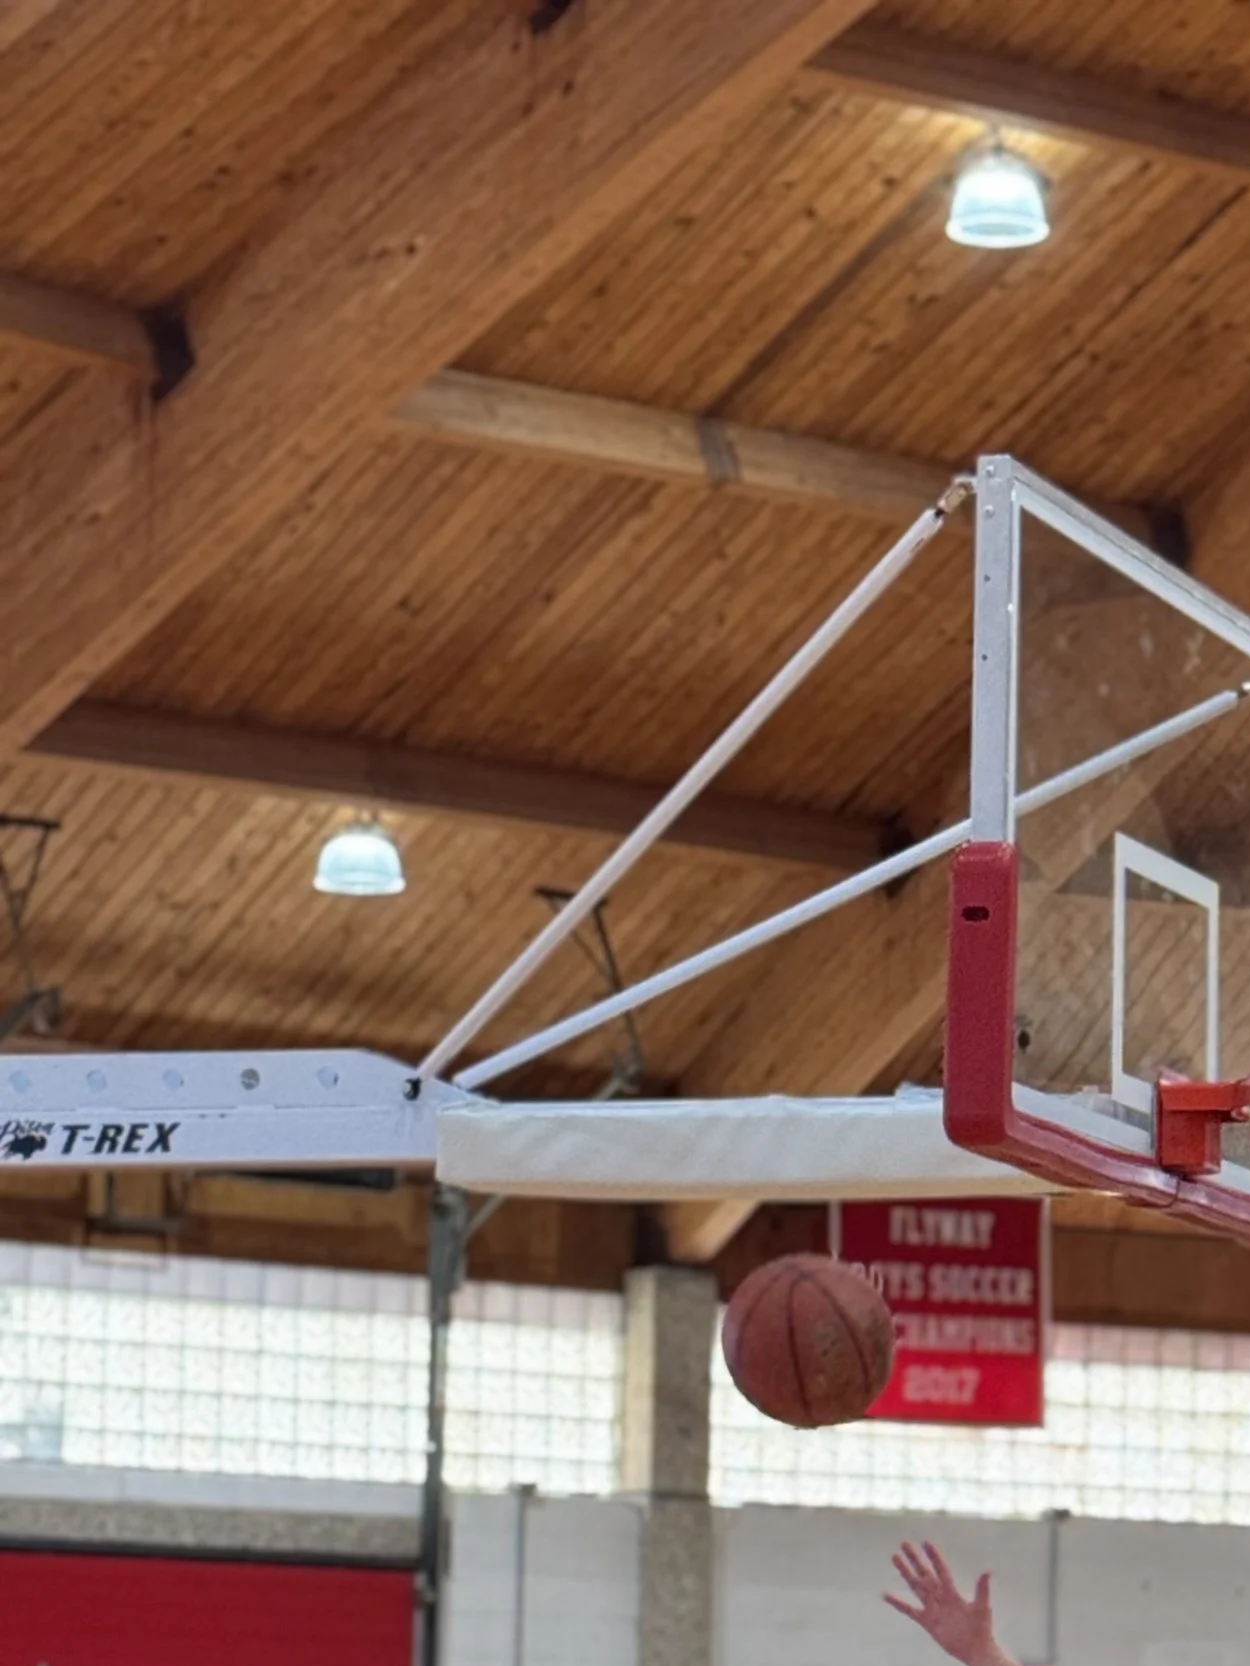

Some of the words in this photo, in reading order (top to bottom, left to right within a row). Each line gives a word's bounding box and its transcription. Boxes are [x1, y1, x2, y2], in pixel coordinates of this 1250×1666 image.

[61, 1122, 181, 1155] T-REX
[889, 1206, 996, 1249] FLYWAY
[929, 1264, 1035, 1306] SOCCER
